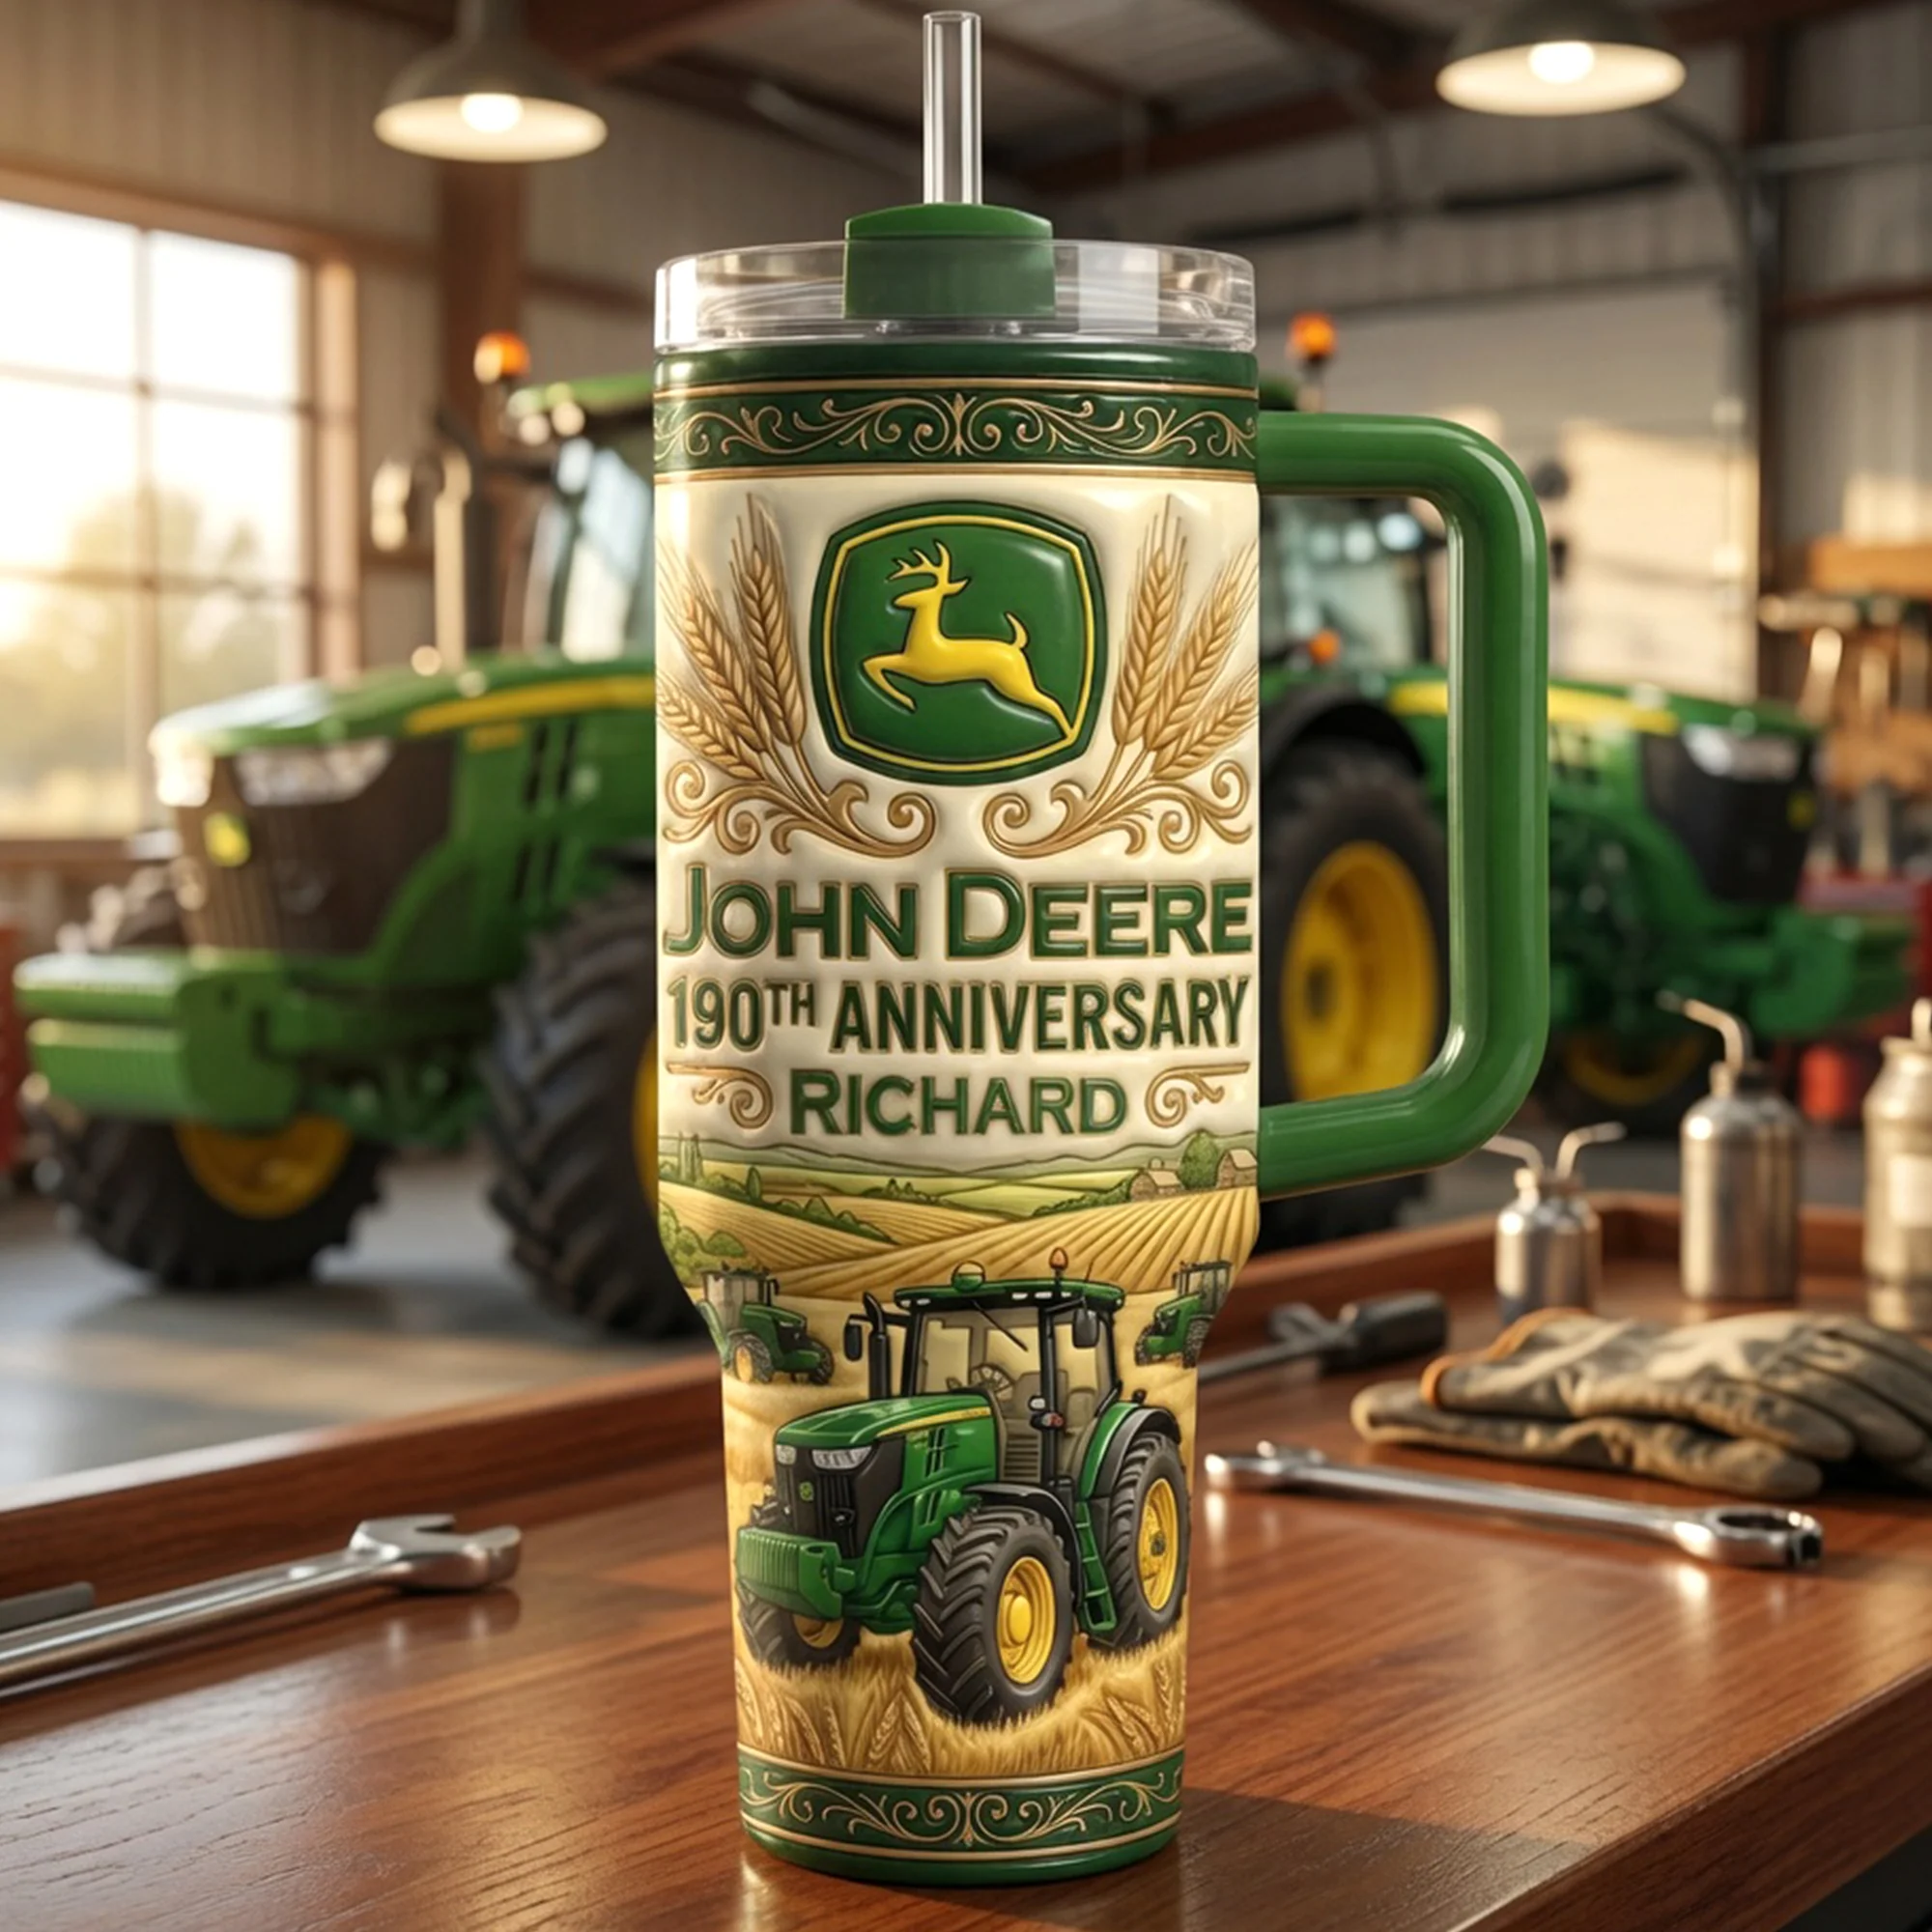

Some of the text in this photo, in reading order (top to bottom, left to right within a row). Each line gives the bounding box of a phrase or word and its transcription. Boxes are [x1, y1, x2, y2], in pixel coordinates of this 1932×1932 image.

[664, 863, 1254, 960] JOHN DEERE
[668, 974, 1251, 1054] 190TH ANNIVERSARY
[789, 1067, 1128, 1136] RICHARD
